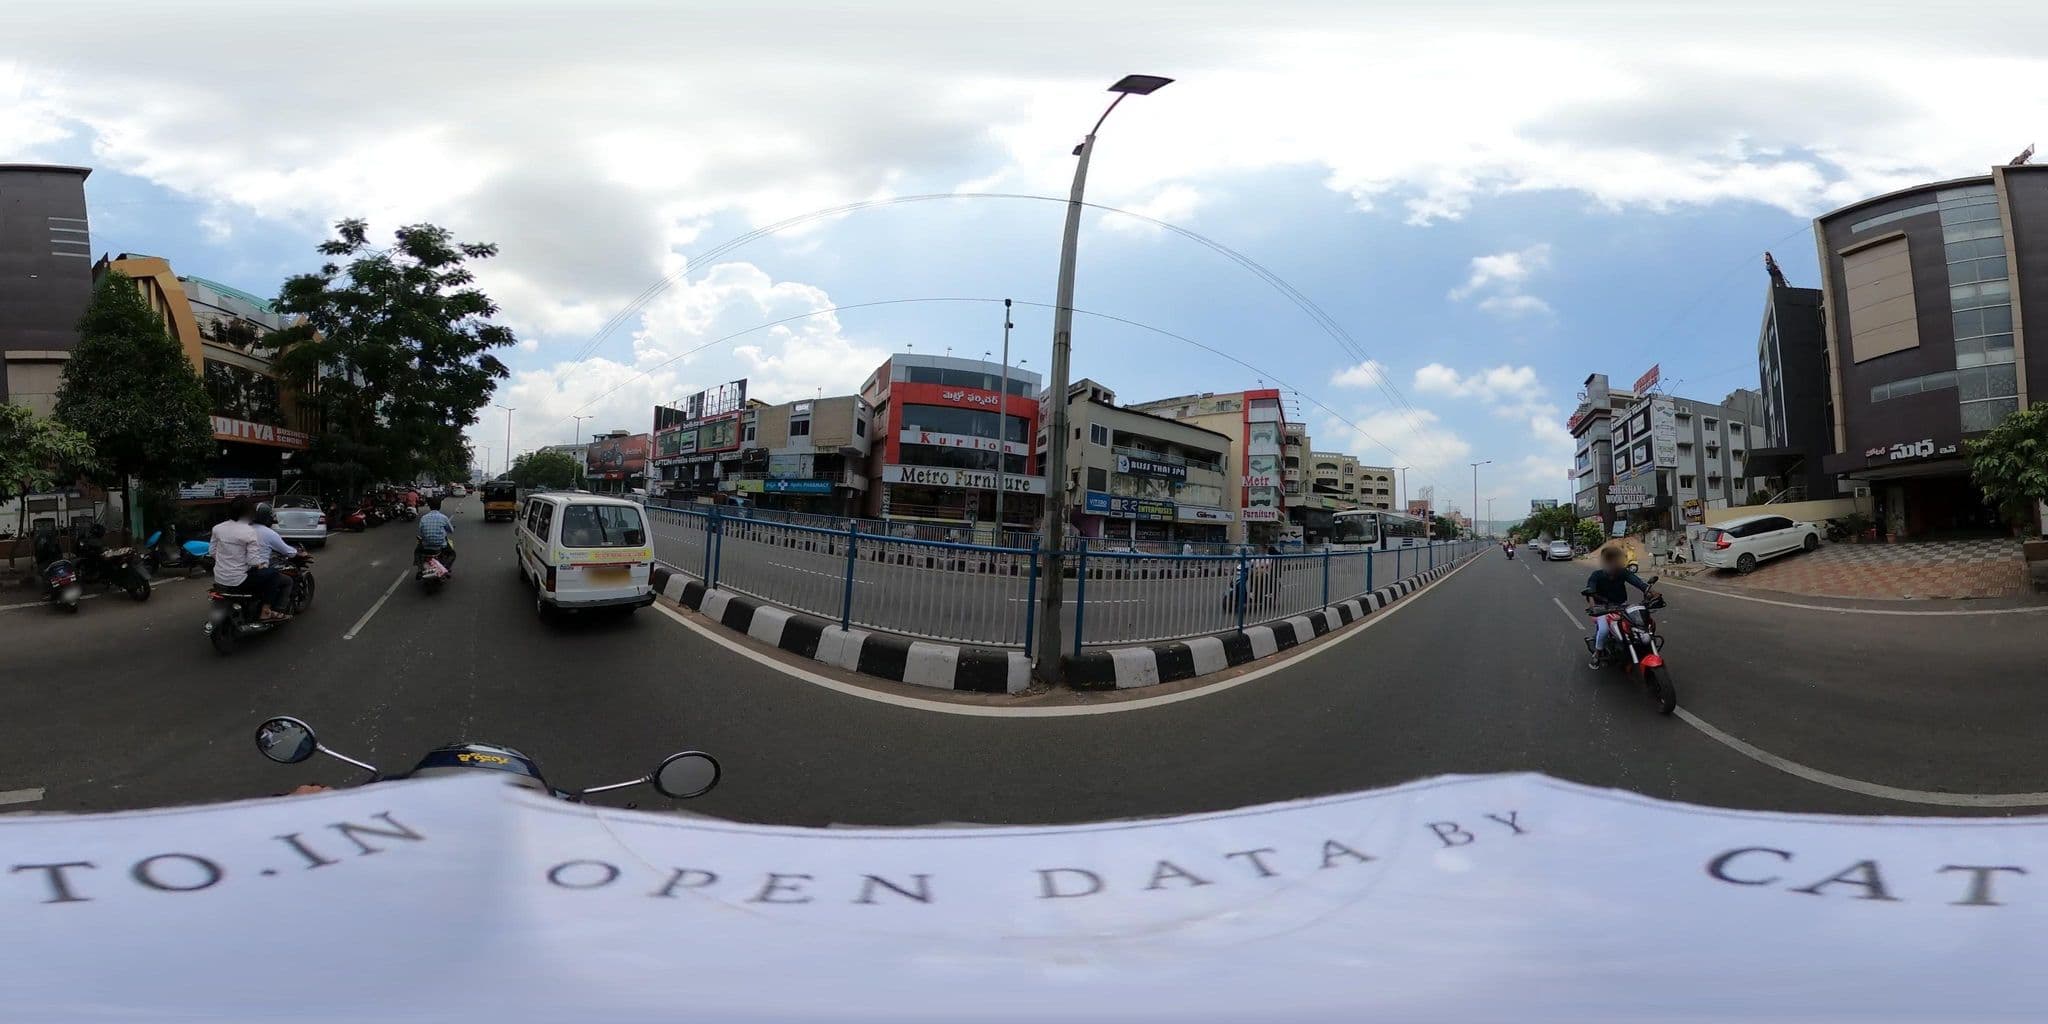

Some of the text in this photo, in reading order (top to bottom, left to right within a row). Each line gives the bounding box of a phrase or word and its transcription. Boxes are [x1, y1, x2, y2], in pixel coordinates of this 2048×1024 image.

[921, 432, 1012, 453] Kurlon
[900, 467, 949, 484] Metro
[1131, 461, 1151, 470] BLISS
[1152, 464, 1170, 474] THAI
[1172, 467, 1185, 476] SPA
[1243, 510, 1275, 519] Furniture
[545, 809, 2031, 907] OPEN DATA BY CAT
